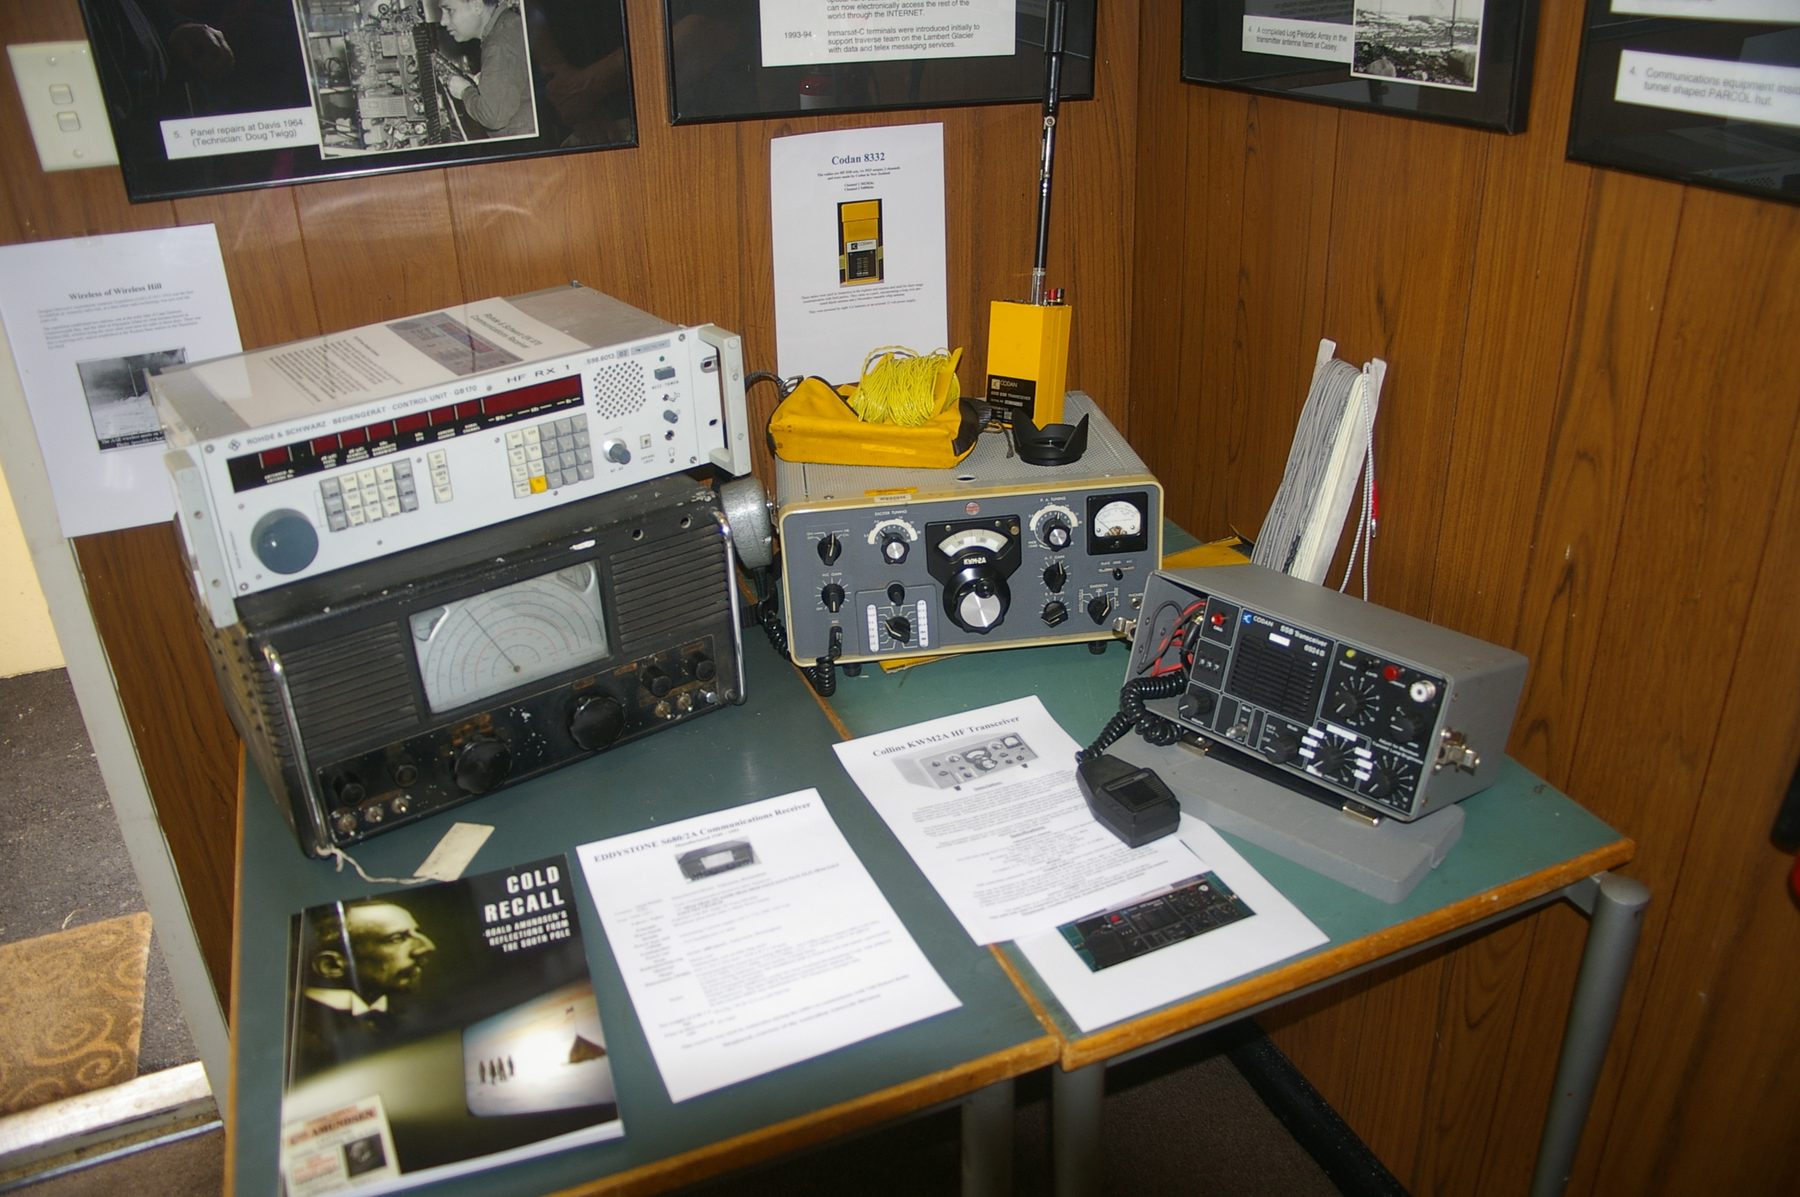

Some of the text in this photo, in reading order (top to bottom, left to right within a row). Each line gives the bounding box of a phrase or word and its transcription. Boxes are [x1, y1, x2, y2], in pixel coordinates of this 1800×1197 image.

[827, 12, 846, 20] world
[847, 11, 873, 20] through
[874, 10, 885, 18] the
[857, 1, 900, 11] electronically
[901, 1, 925, 9] access
[828, 28, 865, 37] Inmarsat-C
[867, 27, 897, 36] terminals
[915, 25, 950, 33] introduced
[951, 24, 973, 33] initially
[973, 23, 981, 31] to
[828, 37, 854, 46] support
[855, 36, 882, 44] traverse
[883, 35, 900, 43] team
[911, 33, 923, 41] the
[923, 32, 951, 41] Lambert
[951, 31, 974, 40] Glacier
[1287, 29, 1296, 38] Log
[1318, 31, 1332, 41] Array
[828, 46, 842, 54] with
[844, 45, 858, 53] data
[859, 44, 873, 52] and
[874, 42, 890, 51] telex
[891, 42, 927, 52] messaging
[1281, 39, 1301, 47] antenna
[1646, 67, 1721, 86] Communications
[1723, 77, 1775, 93] equipment
[1644, 81, 1672, 93] tunnel
[1673, 86, 1706, 99] shaped
[1708, 90, 1752, 104] PARCOL
[190, 127, 215, 137] Panel
[217, 124, 246, 137] repairs
[248, 123, 256, 131] at
[258, 120, 281, 130] Davis
[192, 128, 298, 147] (Technician: Doug Twigg)
[831, 152, 885, 166] Codan 8332
[68, 282, 162, 301] Wireless of Wireless Hill
[507, 374, 526, 384] HF
[534, 367, 556, 378] RX
[246, 432, 275, 446] ROHDE
[285, 420, 327, 437] SCHWARZ
[392, 397, 428, 411] CONTROL
[429, 392, 448, 402] UNIT
[1252, 614, 1328, 648] CODAN SSB Transceiver
[872, 716, 1020, 757] Collins KWM2A HF Transceiver
[593, 840, 659, 863] EDDYSTONE
[699, 811, 773, 836] Communications
[775, 802, 811, 816] Receiver
[506, 865, 560, 894] COLD
[484, 888, 565, 923] RECALL
[484, 910, 568, 938] ROALD AMUNDSEN'S
[489, 919, 570, 947] REFLECTIONS FROM
[502, 928, 571, 953] THE SOUTH POLE
